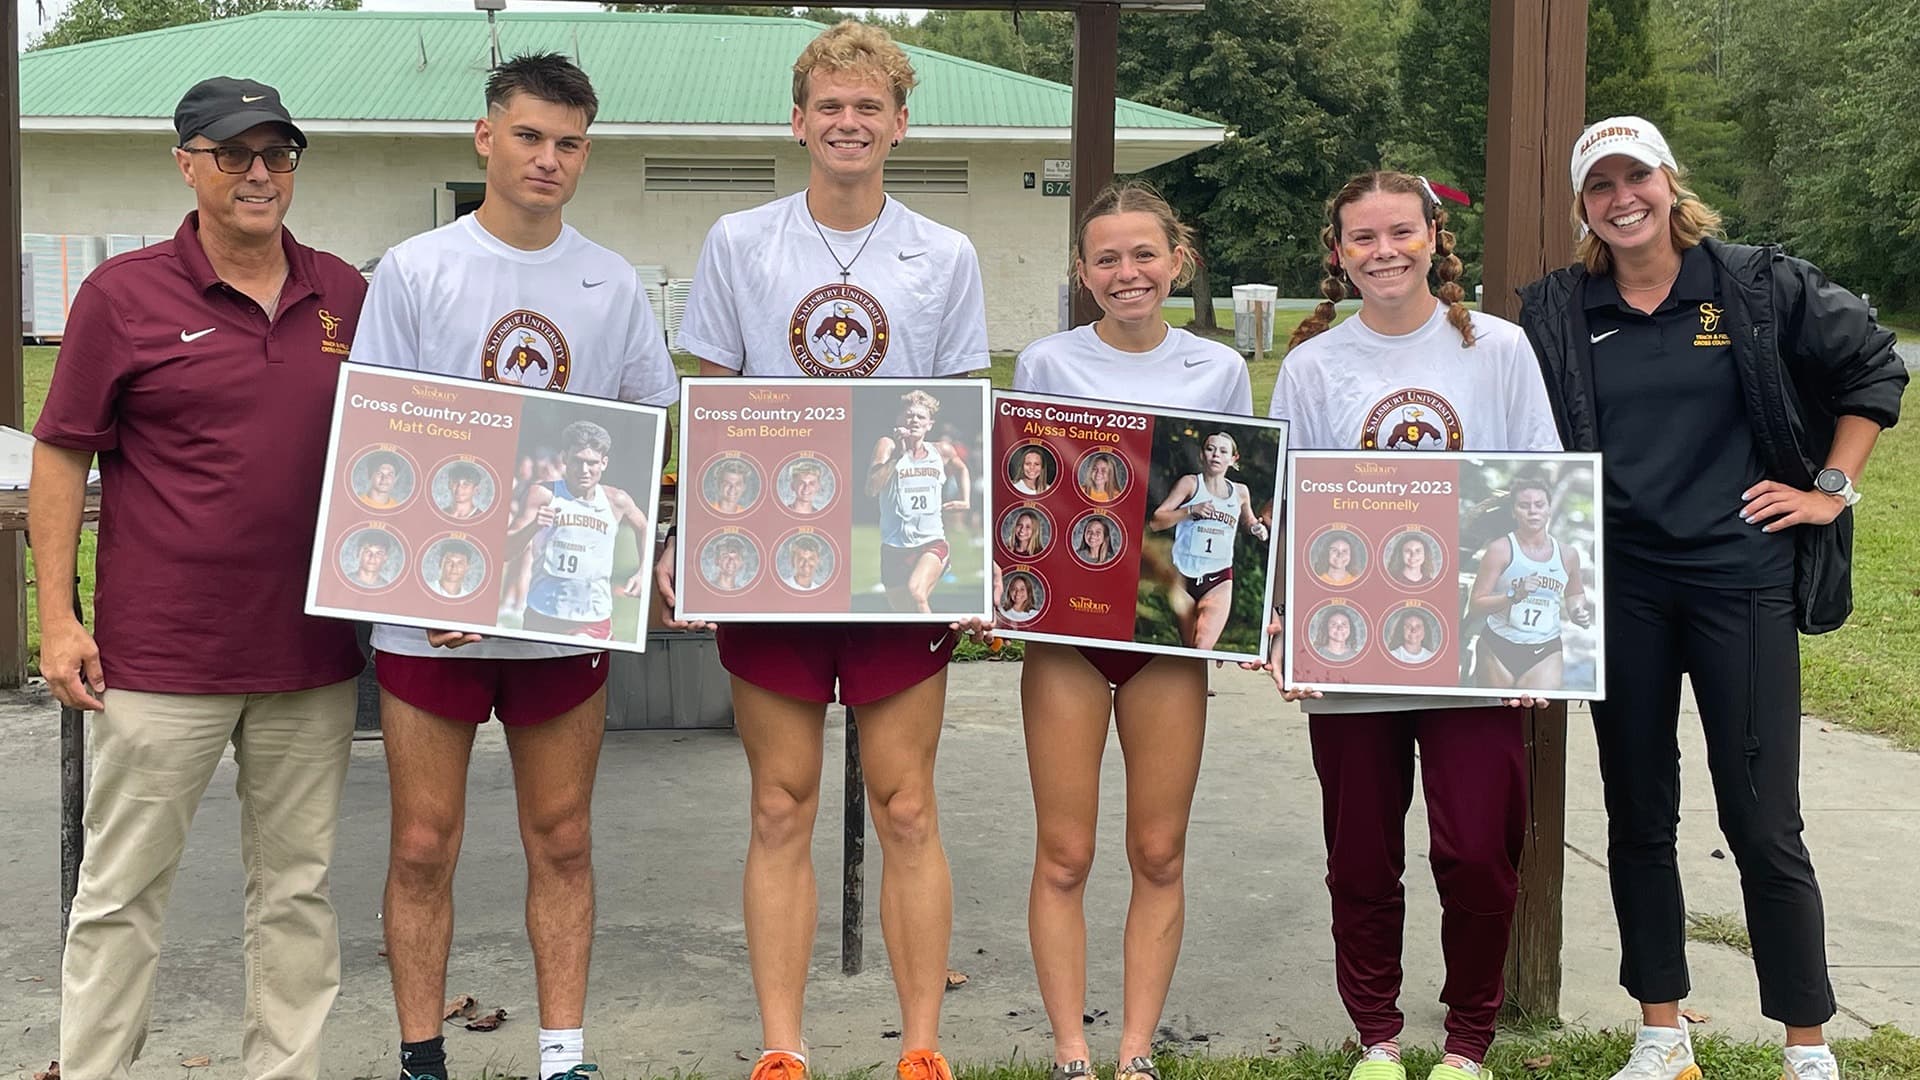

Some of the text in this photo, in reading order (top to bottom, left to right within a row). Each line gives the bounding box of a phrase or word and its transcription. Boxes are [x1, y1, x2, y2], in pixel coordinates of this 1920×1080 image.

[1580, 126, 1640, 156] SALISBURY
[797, 287, 883, 327] SALISBURY UNIVERSITY
[522, 314, 566, 360] UNIVERSITY
[835, 321, 848, 337] S
[350, 394, 514, 430] Cross Country 2023
[694, 407, 846, 423] Cross Country 2023
[1000, 402, 1147, 430] Cross Country 2023
[1367, 391, 1456, 434] SALISBURY UNIVERSITY
[389, 418, 472, 441] Matt Grossi
[727, 425, 813, 438] Sam Bodmer
[1023, 421, 1120, 443] Alyssa Santoro
[1407, 425, 1420, 441] S
[1301, 479, 1453, 496] Cross Country 2023
[910, 495, 928, 510] 28
[1333, 498, 1420, 512] Erin Connelly
[1205, 538, 1213, 554] 1
[557, 553, 578, 574] 19
[1068, 597, 1112, 614] Salisbury
[1522, 608, 1542, 627] 17
